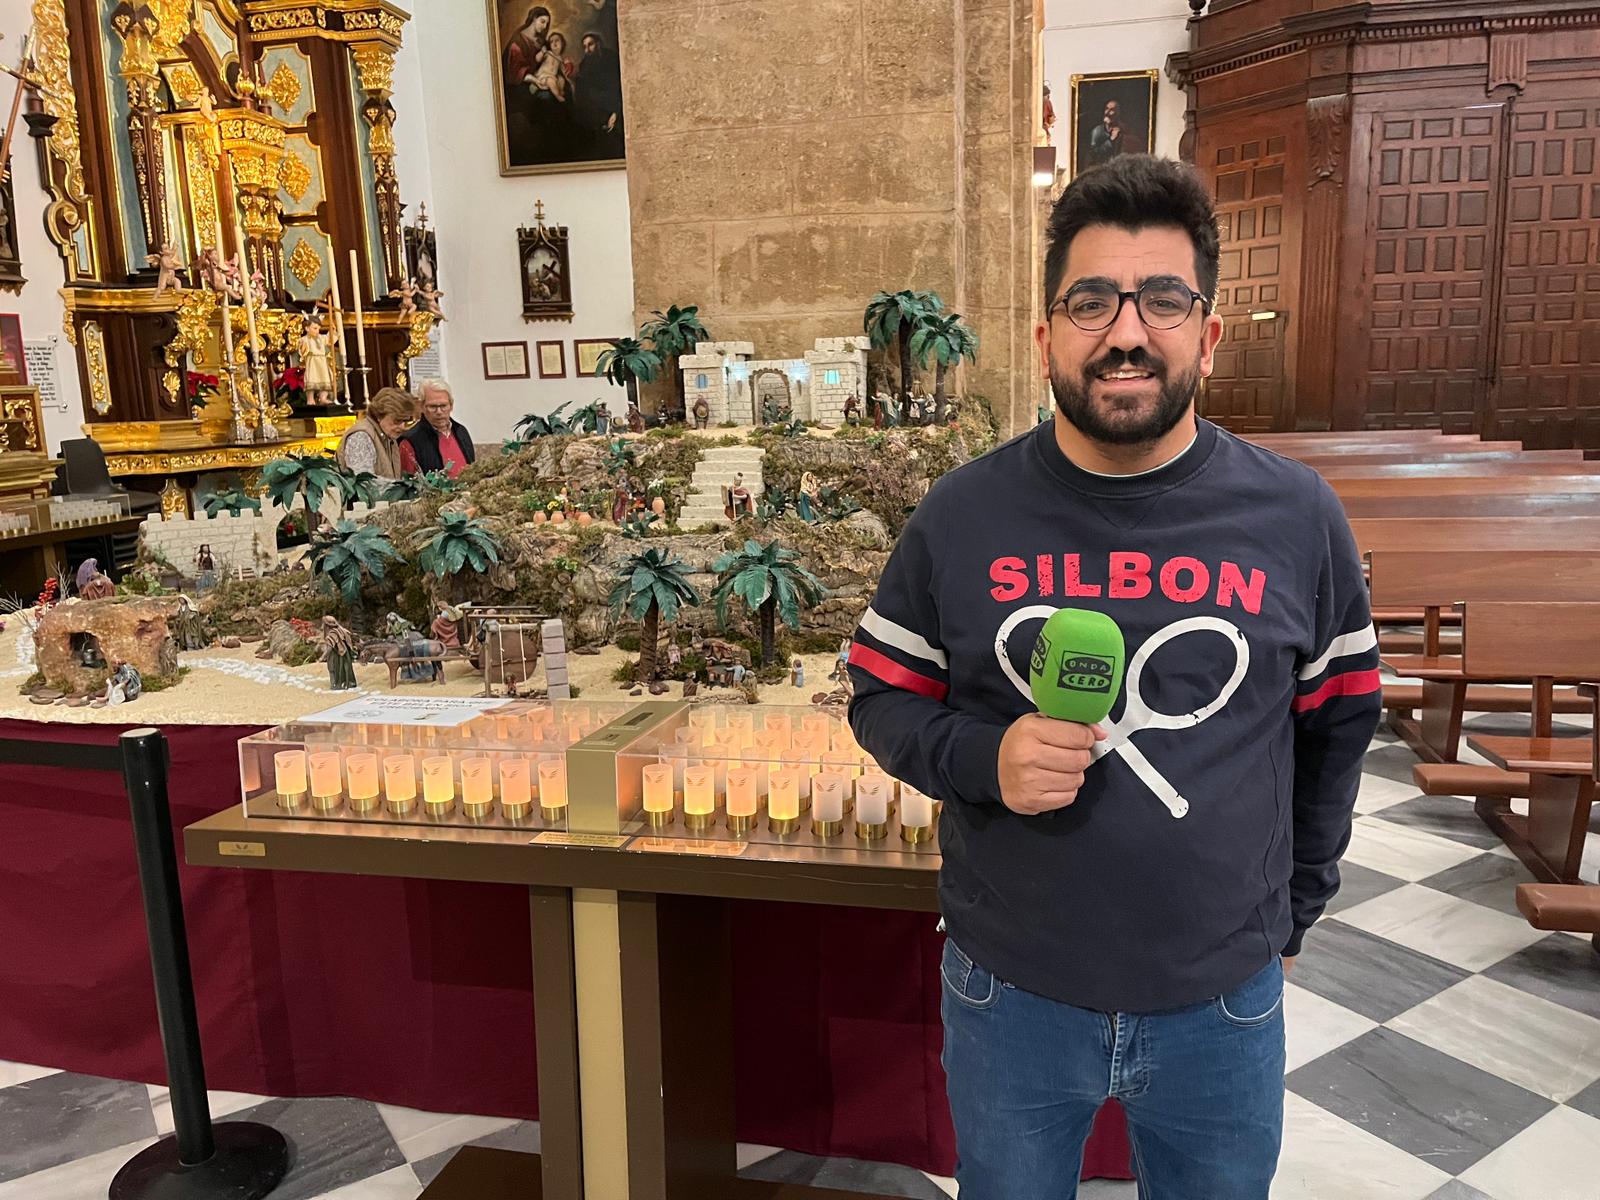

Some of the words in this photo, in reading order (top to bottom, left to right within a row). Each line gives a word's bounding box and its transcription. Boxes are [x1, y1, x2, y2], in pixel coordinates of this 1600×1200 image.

[989, 551, 1267, 615] SILBON
[1069, 660, 1108, 671] ONDA
[1068, 674, 1105, 687] CERO
